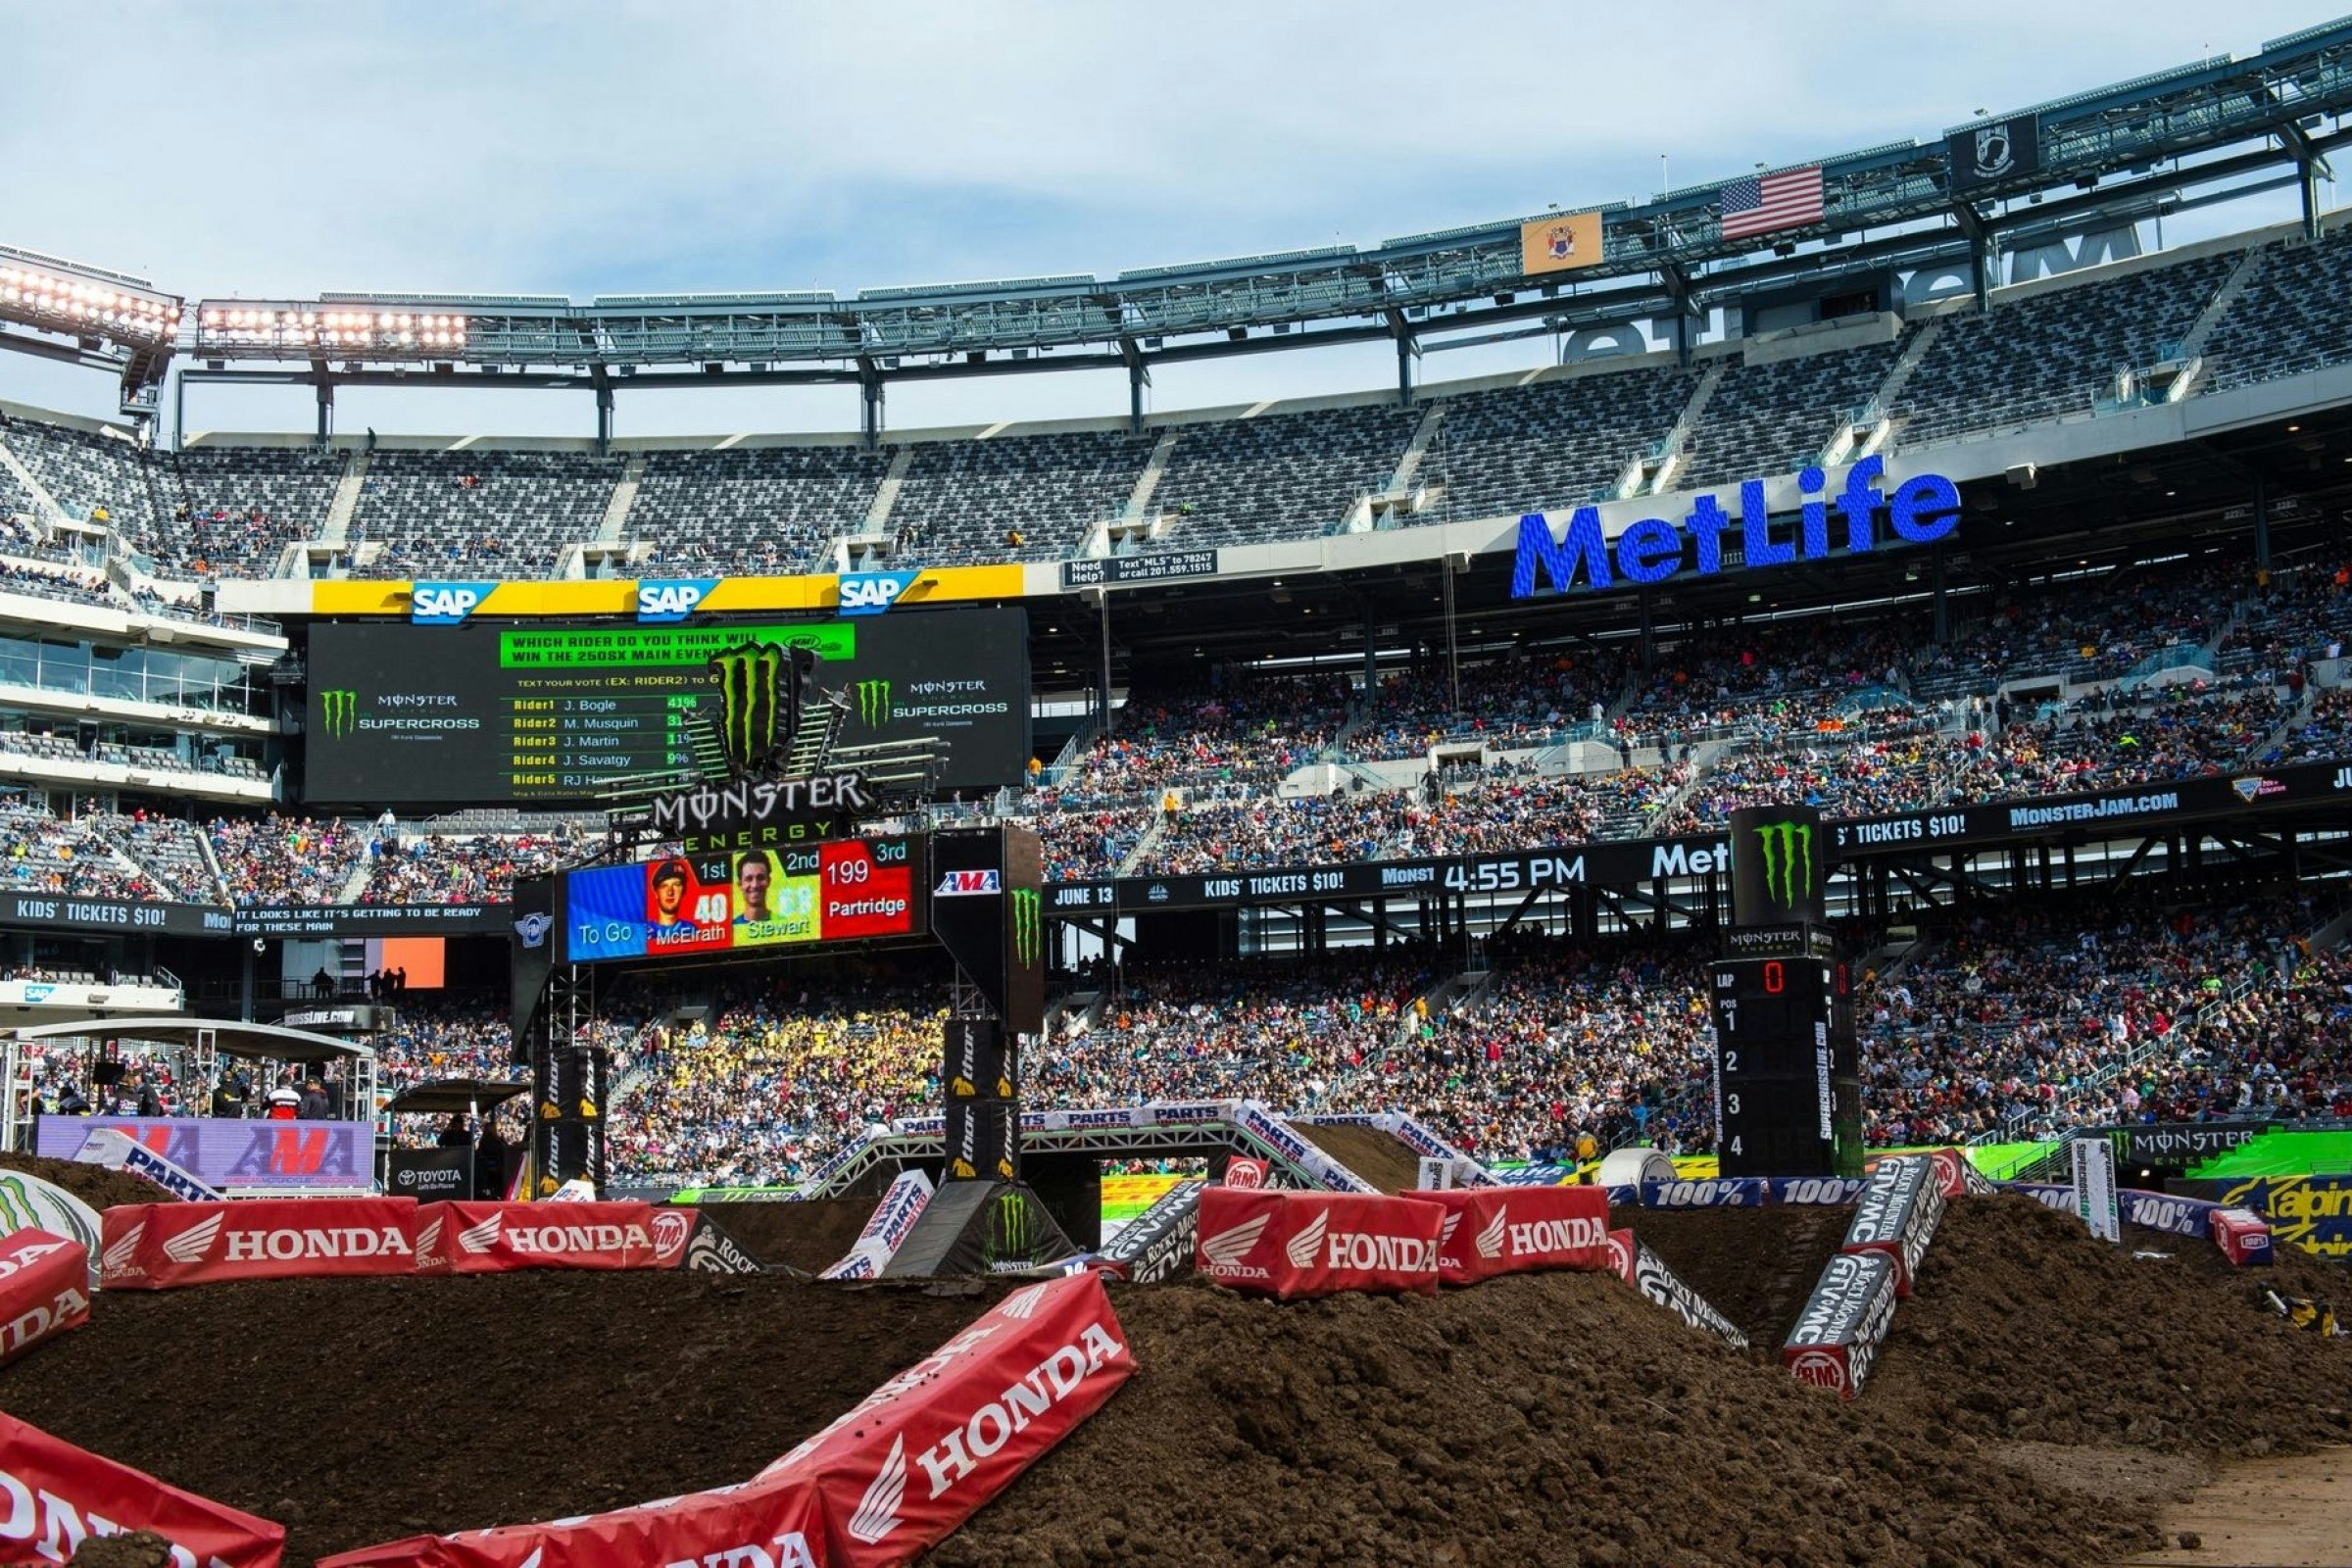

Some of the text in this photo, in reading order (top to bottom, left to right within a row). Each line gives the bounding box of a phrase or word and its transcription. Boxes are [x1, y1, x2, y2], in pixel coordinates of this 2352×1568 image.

[1511, 453, 1961, 600] MetLife
[1072, 561, 1101, 572] Need
[1118, 561, 1139, 569] Text
[1172, 556, 1182, 564] to
[1072, 571, 1104, 583] Help?
[1119, 570, 1129, 579] or
[1131, 568, 1149, 578] call
[413, 589, 477, 616] SAP
[638, 586, 700, 616] SAP
[840, 579, 900, 608] SAP
[513, 637, 563, 649] WHICH
[568, 637, 612, 648] RIDER
[617, 637, 636, 648] DO
[644, 636, 671, 647] YOU
[677, 635, 720, 646] THINK
[513, 652, 543, 662] WIN
[548, 651, 572, 662] THE
[578, 651, 626, 662] 250SX
[632, 649, 671, 660] MAIN
[605, 677, 631, 686] (EX:
[634, 676, 688, 685] RIDER2)
[910, 680, 986, 695] MONSTER
[378, 694, 458, 707] MONSTER
[514, 698, 696, 712] Rider1 J. Bogle 41%
[893, 703, 1007, 718] SUPERCROSS
[359, 718, 480, 729] SUPERCROSS
[514, 718, 557, 728] Rider2
[564, 718, 579, 729] M.
[584, 717, 638, 731] Musquin
[513, 736, 619, 747] Rider3 J. Martin
[513, 754, 689, 767] Rider4 J. Savatgy 9%
[513, 774, 556, 785] Rider5
[564, 775, 581, 786] RJ
[654, 772, 867, 831] MONSTER
[686, 820, 831, 852] ENERGY
[1856, 814, 1966, 844] TICKETS $10!
[787, 850, 819, 870] 2nd
[876, 841, 906, 862] 3rd
[700, 860, 726, 880] 1st
[827, 859, 869, 884] 199
[1445, 856, 1585, 891] 4:55 PM
[933, 869, 1002, 897] AMA
[1204, 871, 1345, 899] KIDS' TICKETS $10!
[1055, 887, 1113, 906] JUNE 13
[17, 900, 166, 926] KIDS' TICKETS $10!
[236, 907, 481, 919] IT LOOKS LIKE IT'S GETTING TO BE READY
[694, 893, 727, 923] 40
[829, 898, 906, 918] Partridge
[236, 923, 260, 932] FOR
[306, 922, 333, 931] MAIN
[579, 923, 631, 944] To Go
[656, 926, 726, 946] McElrath
[748, 919, 809, 939] Stewart
[1731, 931, 1800, 946] MONSTER
[1717, 962, 1783, 993] LAP 0
[1720, 999, 1737, 1008] POS
[1725, 1010, 1735, 1031] 1
[1725, 1051, 1738, 1071] 2
[1154, 1105, 1219, 1120] PARTS
[1728, 1094, 1740, 1114] 3
[1068, 1111, 1130, 1124] PARTS
[1313, 1116, 1374, 1126] PARTS
[1249, 1109, 1305, 1158] PARTS
[1400, 1120, 1454, 1159] PARTS
[2135, 1130, 2254, 1153] MONSTER
[224, 1126, 360, 1176] AMA
[1731, 1135, 1743, 1155] 4
[817, 1134, 869, 1181] PARTS
[416, 1169, 462, 1183] TOYOTA
[1656, 1181, 1743, 1206] 100%
[883, 1183, 923, 1247] PARTS
[2132, 1198, 2193, 1232] 100%
[223, 1226, 414, 1261] HONDA
[511, 1224, 653, 1253] HONDA
[1509, 1217, 1607, 1255] HONDA
[1328, 1232, 1440, 1272] HONDA
[1202, 1264, 1270, 1279] HONDA
[915, 1322, 1123, 1500] HONDA
